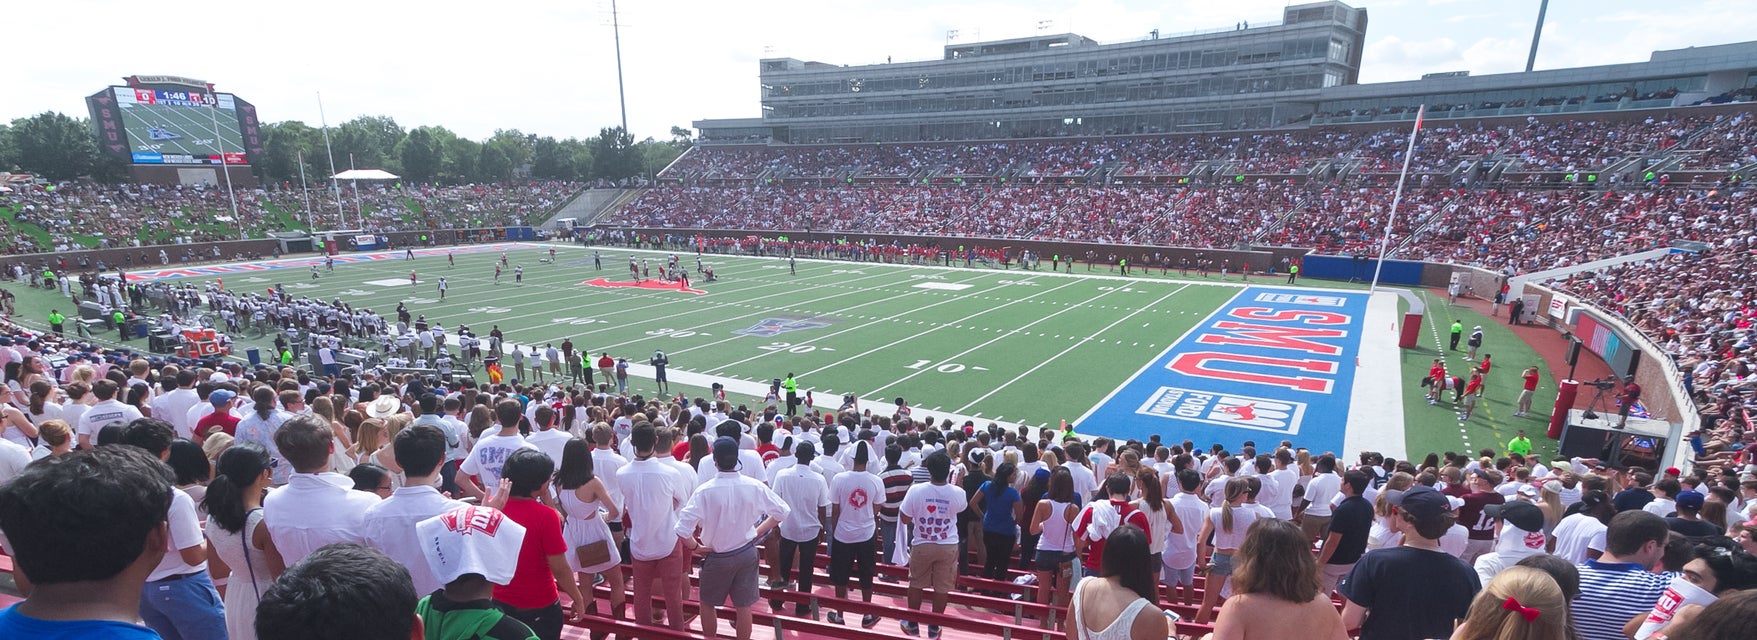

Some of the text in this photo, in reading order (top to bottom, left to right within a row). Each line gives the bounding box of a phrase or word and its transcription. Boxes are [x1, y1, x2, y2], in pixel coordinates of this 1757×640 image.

[142, 92, 149, 101] 0
[163, 91, 186, 100] 1:46
[102, 108, 117, 141] SMU
[246, 115, 257, 145] SMU
[205, 344, 216, 353] G
[756, 341, 817, 354] 20
[1164, 307, 1351, 394] SMU
[903, 359, 966, 373] 10
[1174, 392, 1213, 417] FORD
